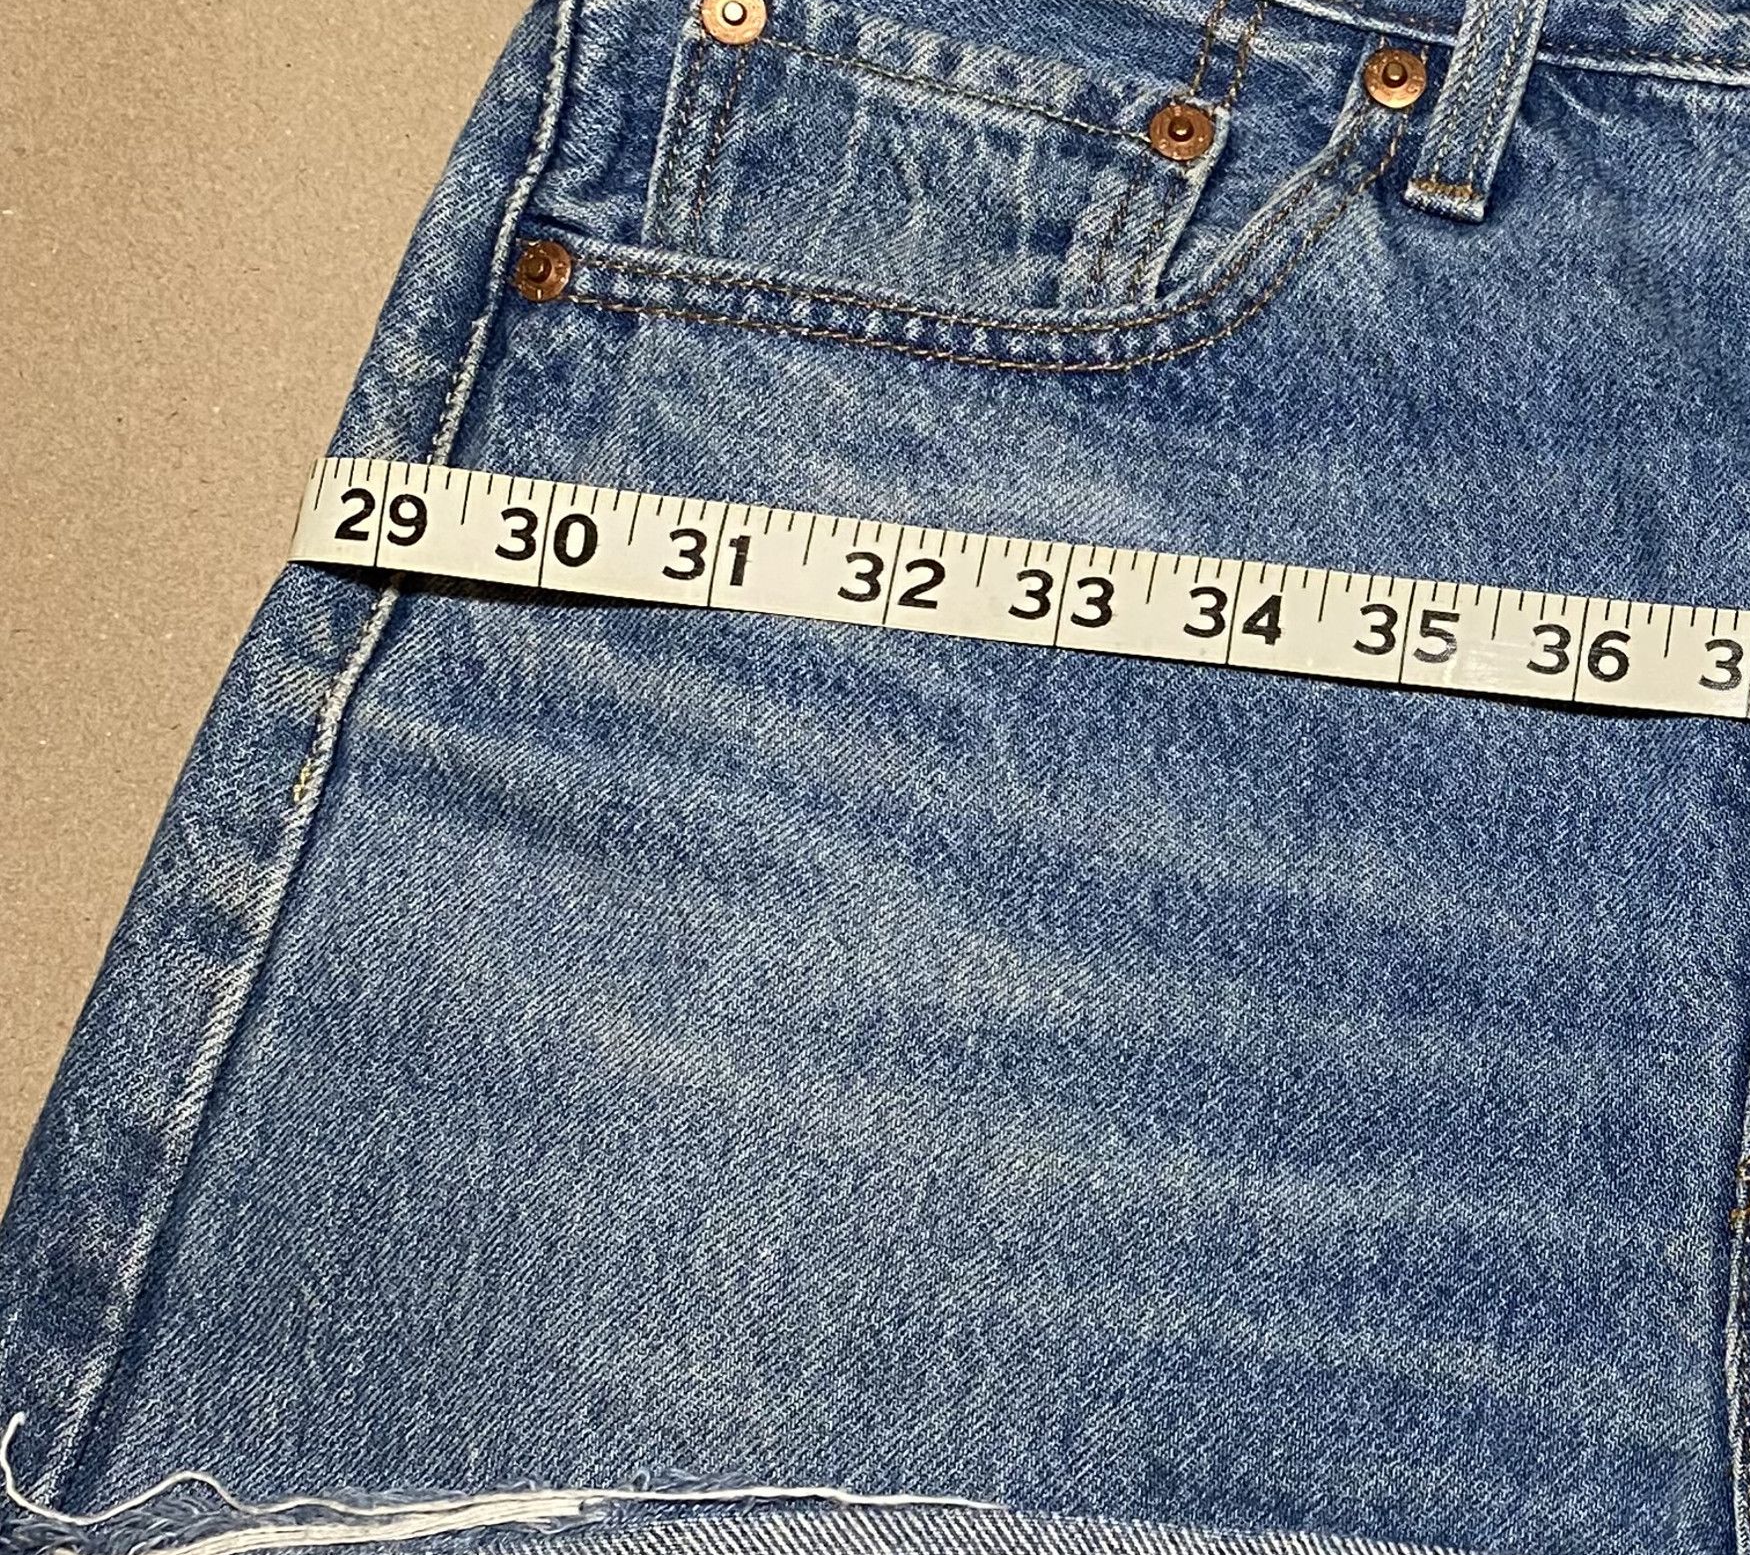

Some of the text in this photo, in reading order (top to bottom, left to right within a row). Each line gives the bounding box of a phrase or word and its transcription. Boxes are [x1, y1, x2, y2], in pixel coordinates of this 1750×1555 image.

[335, 487, 429, 547] 29
[494, 506, 599, 568] 30
[661, 527, 751, 588] 31
[836, 551, 947, 611] 32
[1007, 568, 1115, 629] 33
[1182, 586, 1284, 646] 34
[1351, 602, 1461, 665] 35
[1525, 622, 1631, 683] 36
